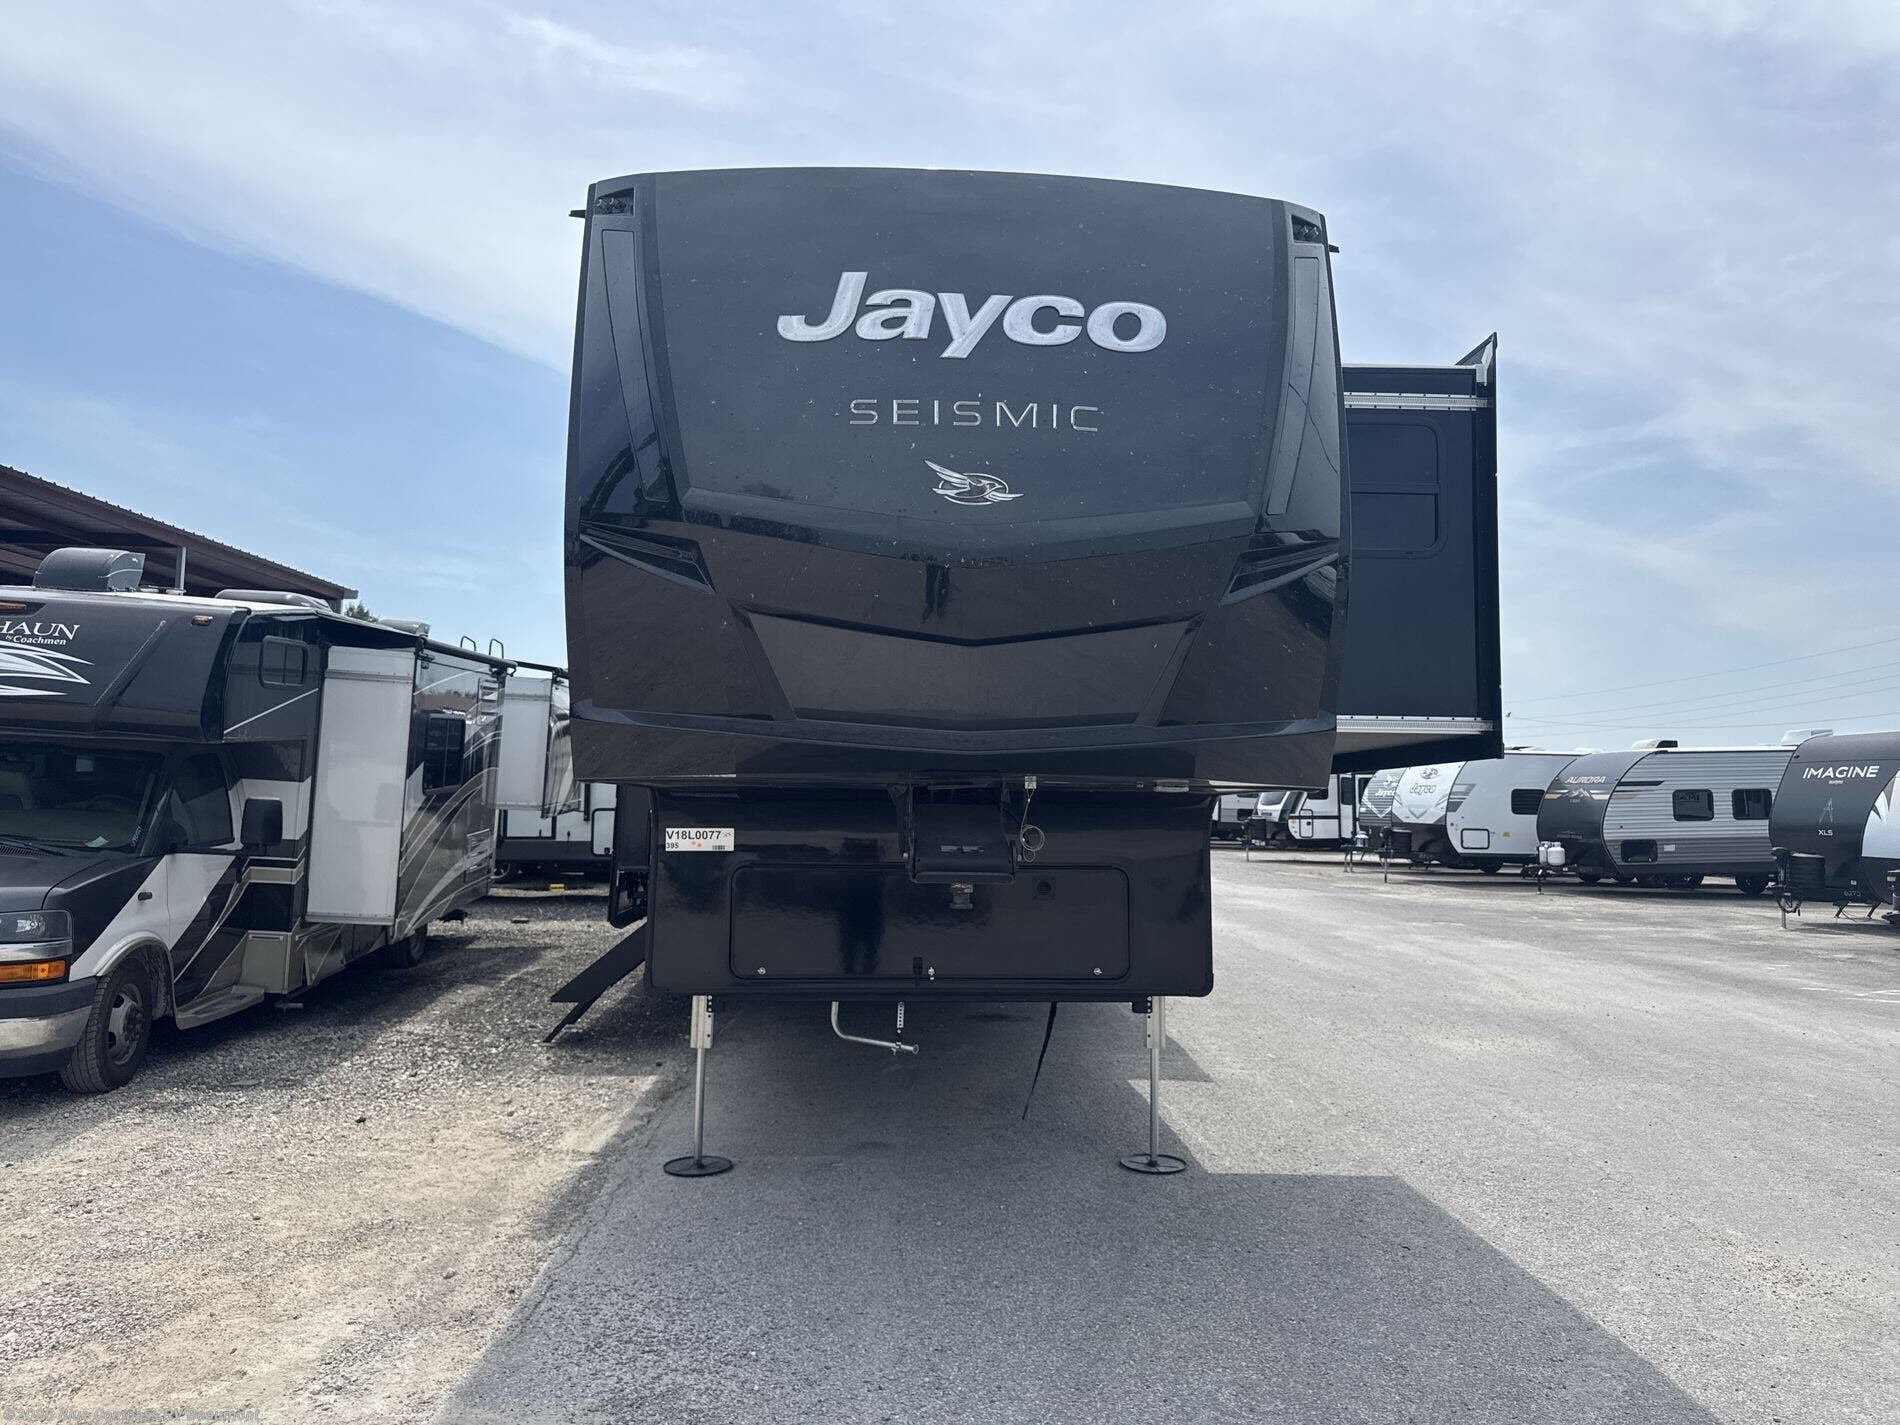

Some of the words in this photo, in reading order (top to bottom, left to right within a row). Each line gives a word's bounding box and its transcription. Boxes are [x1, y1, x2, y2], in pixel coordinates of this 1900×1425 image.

[776, 271, 1168, 359] Jayco
[849, 399, 1099, 432] SEISMIC
[13, 635, 67, 645] Coachmen
[1802, 765, 1880, 779] IMAGINE
[1564, 775, 1606, 784] AURORA
[1409, 783, 1437, 795] Jayco
[666, 830, 722, 840] V18L0077
[666, 842, 680, 850] 395
